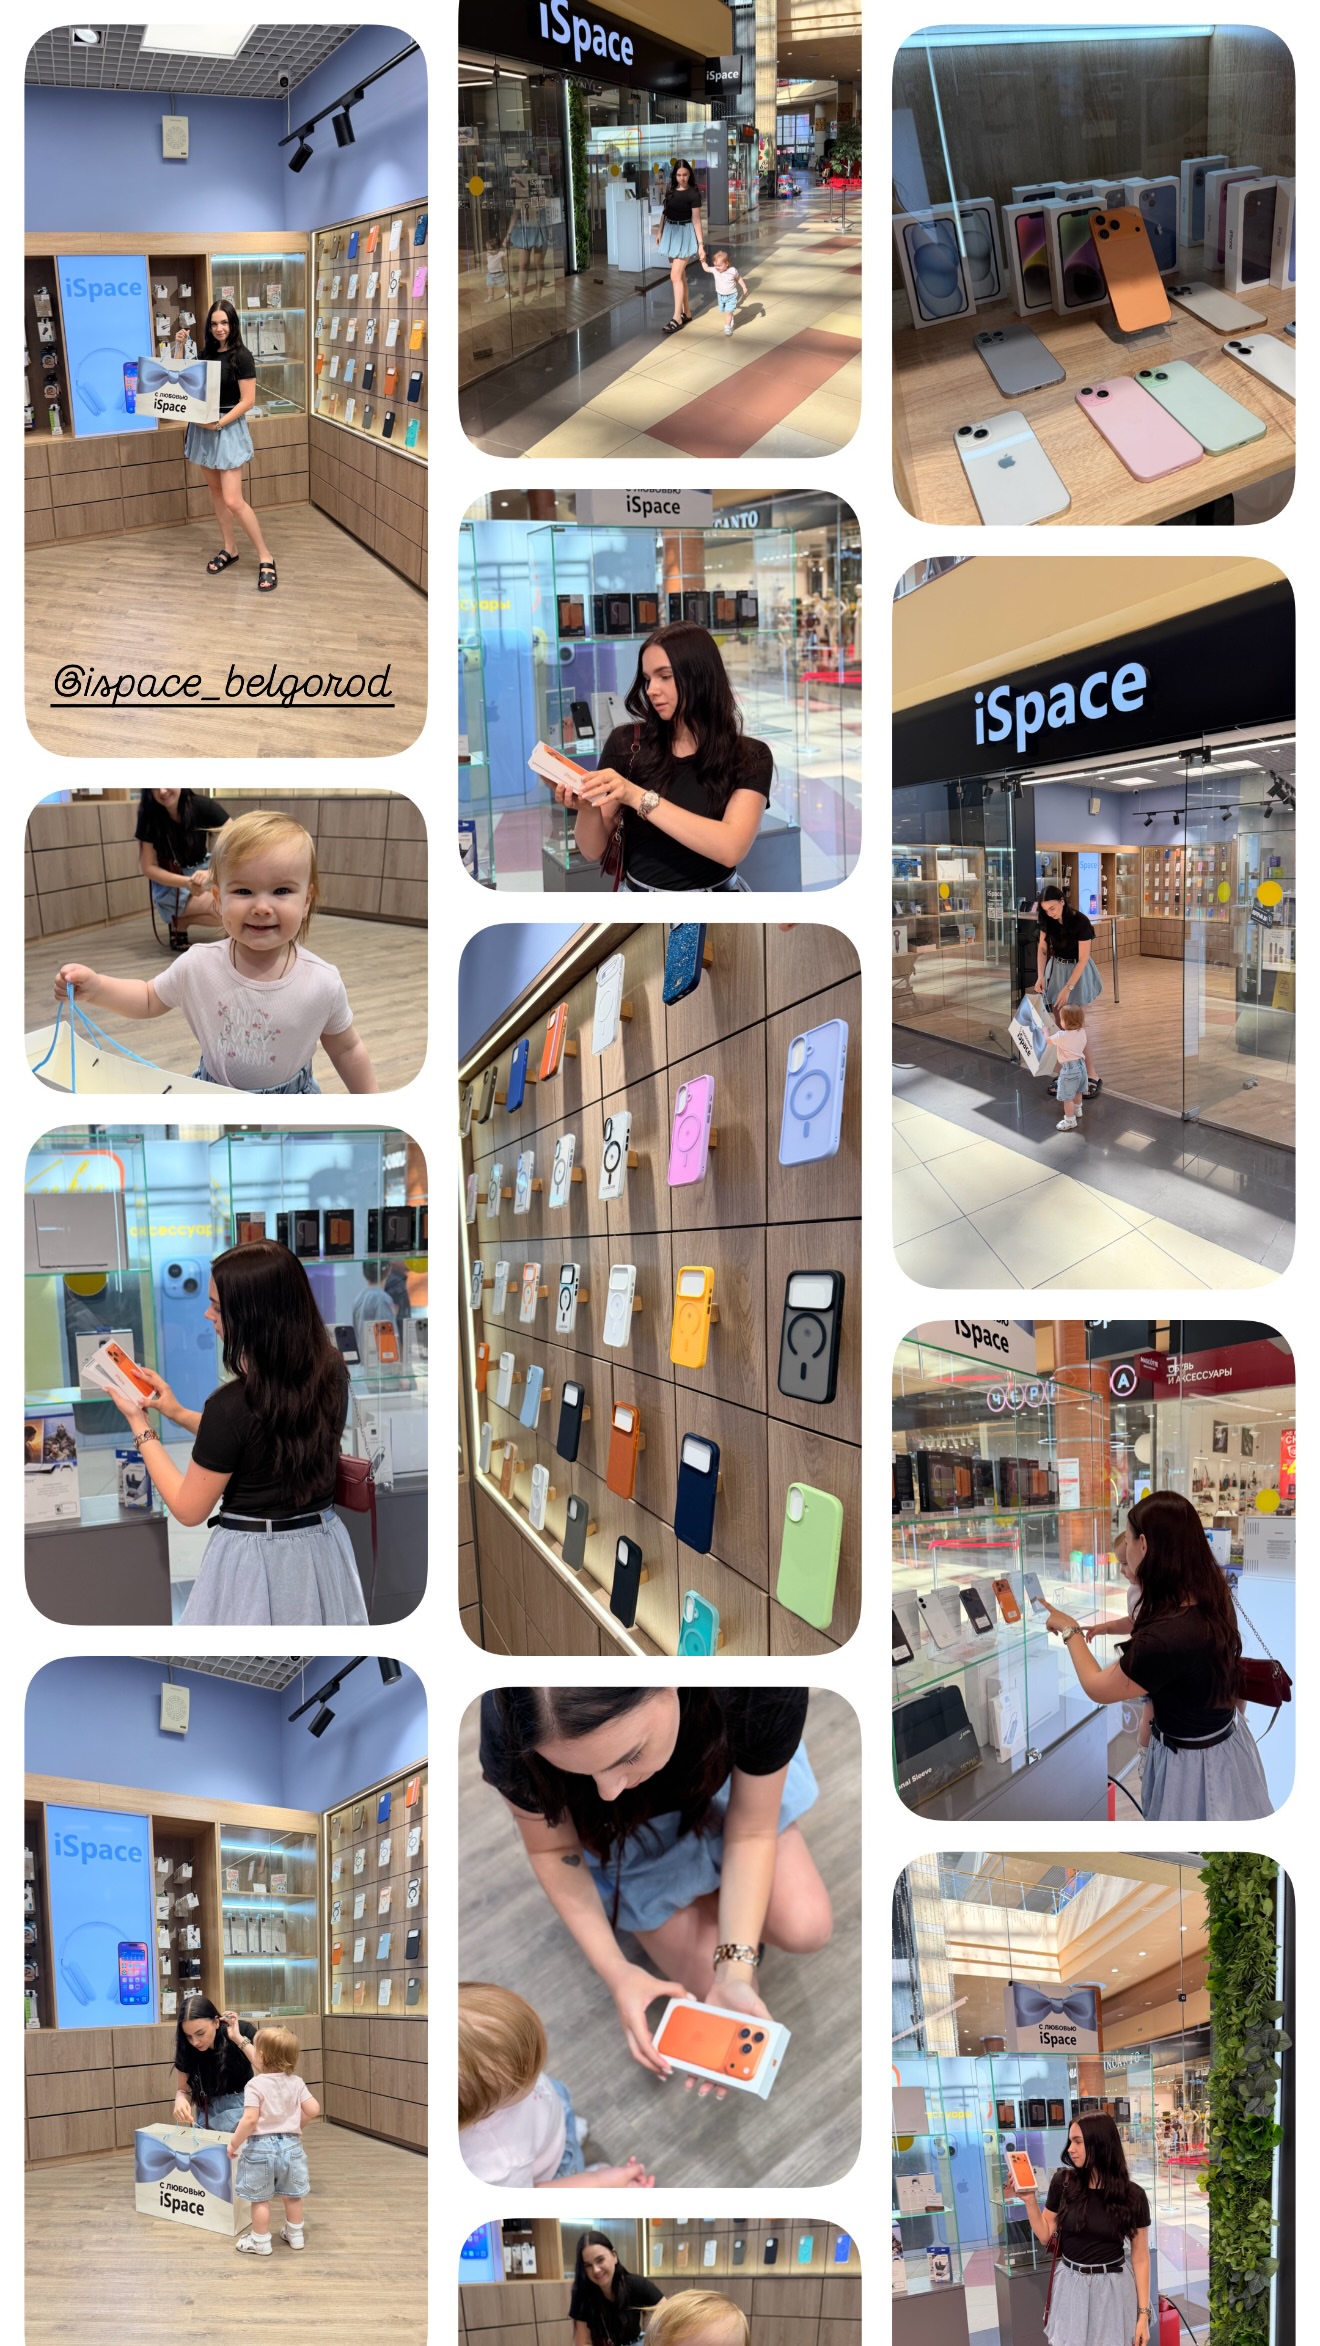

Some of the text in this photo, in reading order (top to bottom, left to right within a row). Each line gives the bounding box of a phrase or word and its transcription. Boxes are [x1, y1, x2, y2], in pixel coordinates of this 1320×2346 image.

[539, 0, 633, 66] iSpace
[706, 69, 739, 82] iSpace
[65, 278, 142, 302] iSpace
[153, 399, 187, 413] iSpace
[626, 495, 681, 518] iSpace
[974, 662, 1147, 753] iSpace
[954, 1320, 1009, 1353] iSpace
[1168, 1367, 1233, 1385] И АКСЕССУАРЫ
[911, 1767, 932, 1784] Sleeve
[54, 1832, 142, 1865] iSpace
[1044, 2024, 1077, 2032] ЛЮБОВЬЮ
[1039, 2032, 1077, 2048] iSpace
[166, 2183, 206, 2198] ЛЮБОВЬЮ
[160, 2191, 205, 2216] iSpace
